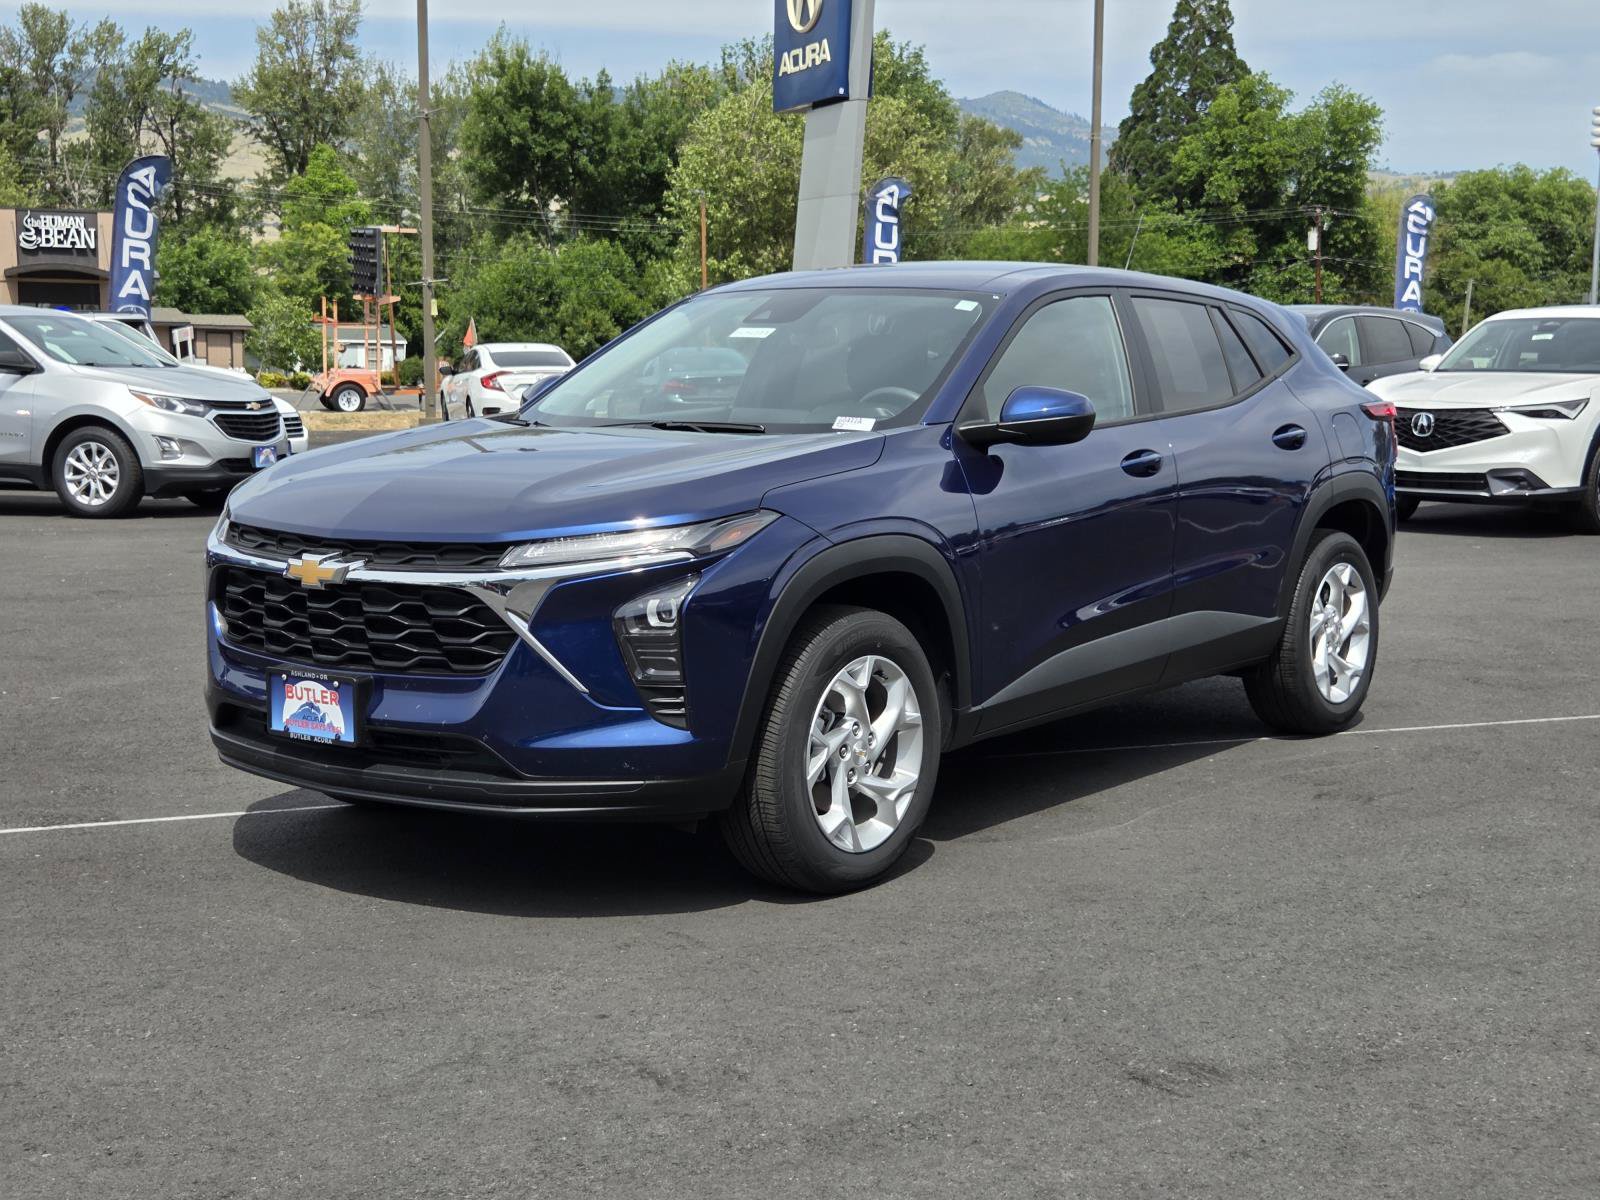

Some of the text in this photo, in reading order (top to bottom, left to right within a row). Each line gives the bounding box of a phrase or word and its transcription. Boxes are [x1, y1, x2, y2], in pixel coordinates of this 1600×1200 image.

[778, 38, 831, 77] ACURA
[40, 215, 85, 230] HUMAN
[118, 165, 157, 301] ACURA
[40, 227, 96, 249] BEAN
[1401, 201, 1432, 306] ACURA
[290, 670, 316, 680] ASHLAND
[284, 683, 340, 706] BUTLER
[289, 733, 333, 744] BUTLER ACURA
